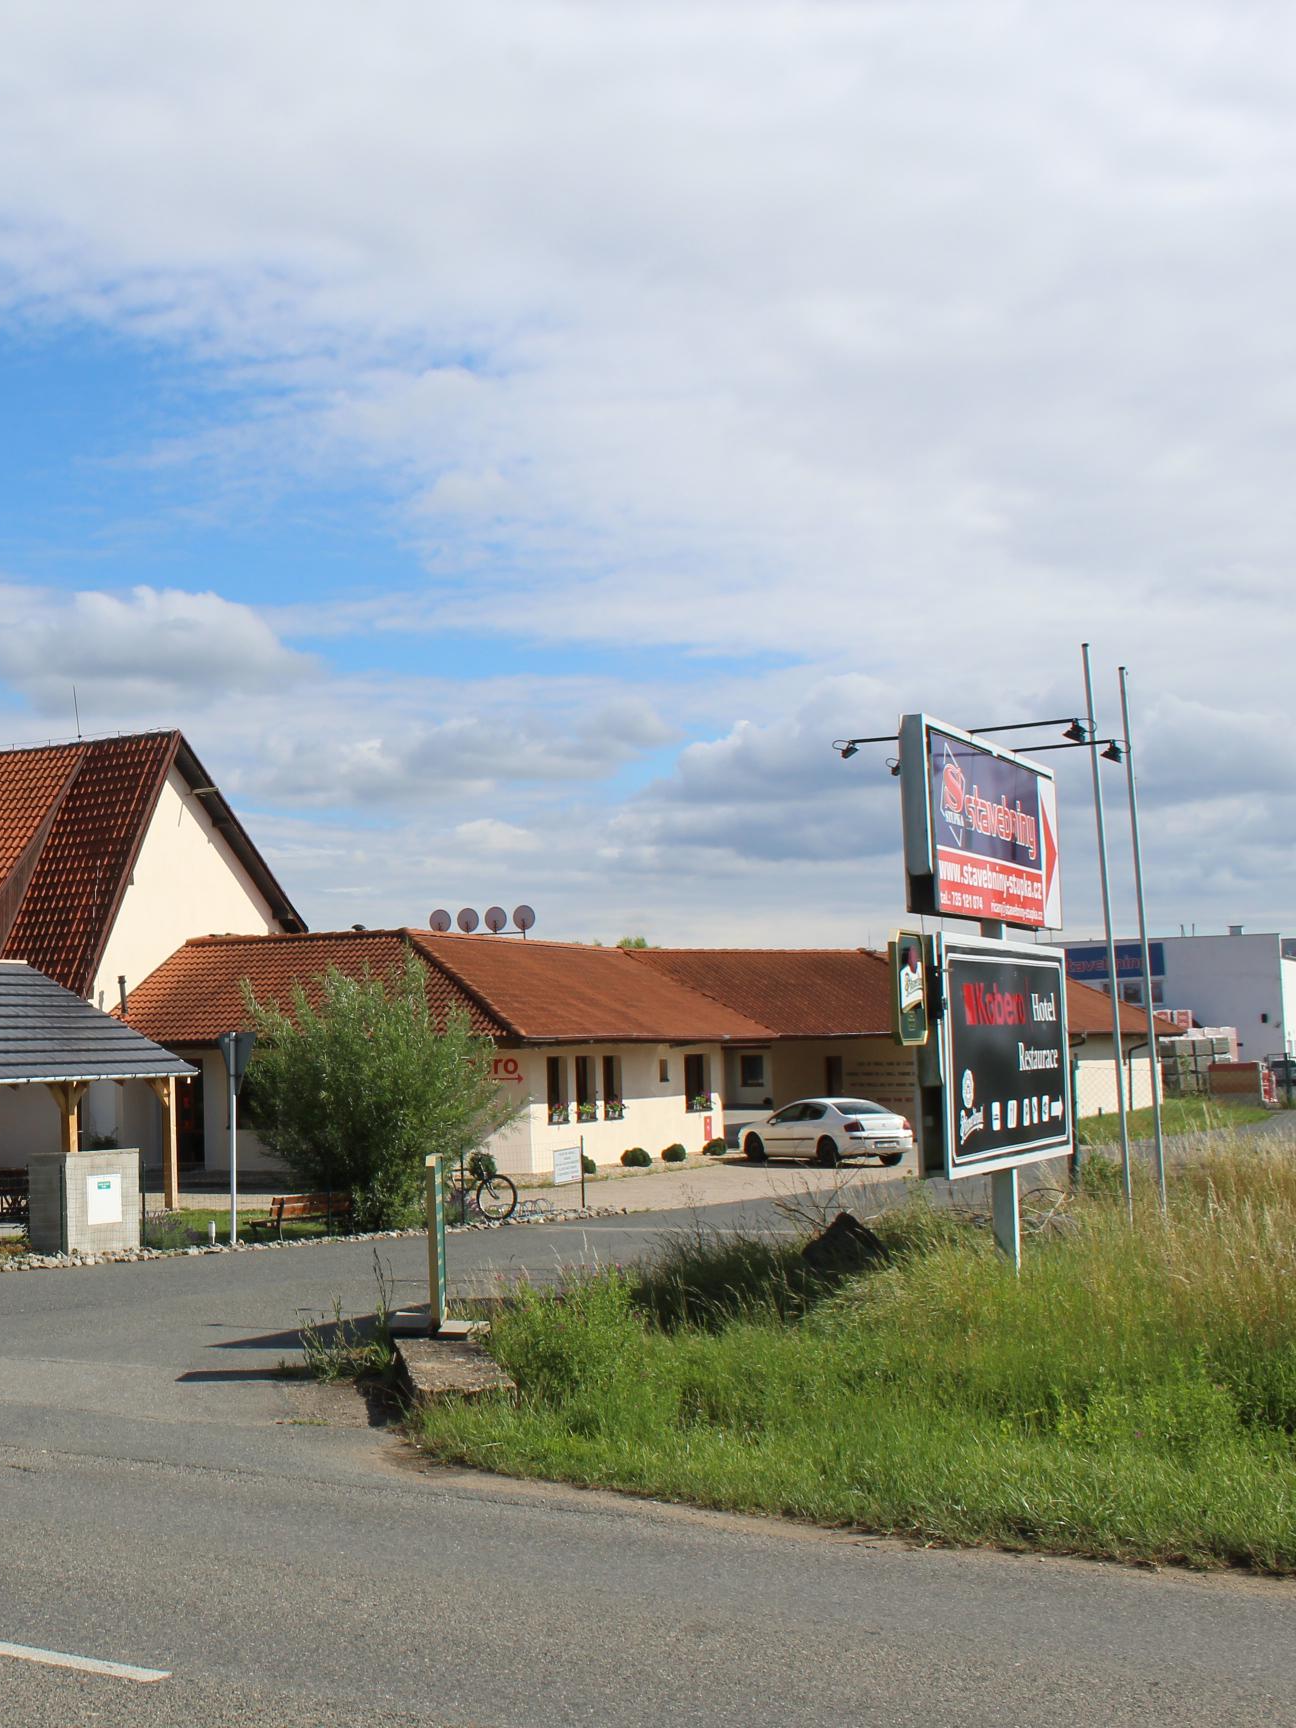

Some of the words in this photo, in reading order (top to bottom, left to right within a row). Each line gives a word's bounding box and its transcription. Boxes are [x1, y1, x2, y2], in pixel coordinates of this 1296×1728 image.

[965, 784, 1037, 860] stavebniny
[1031, 993, 1056, 1021] Hotel
[1018, 1041, 1059, 1071] Restaurace
